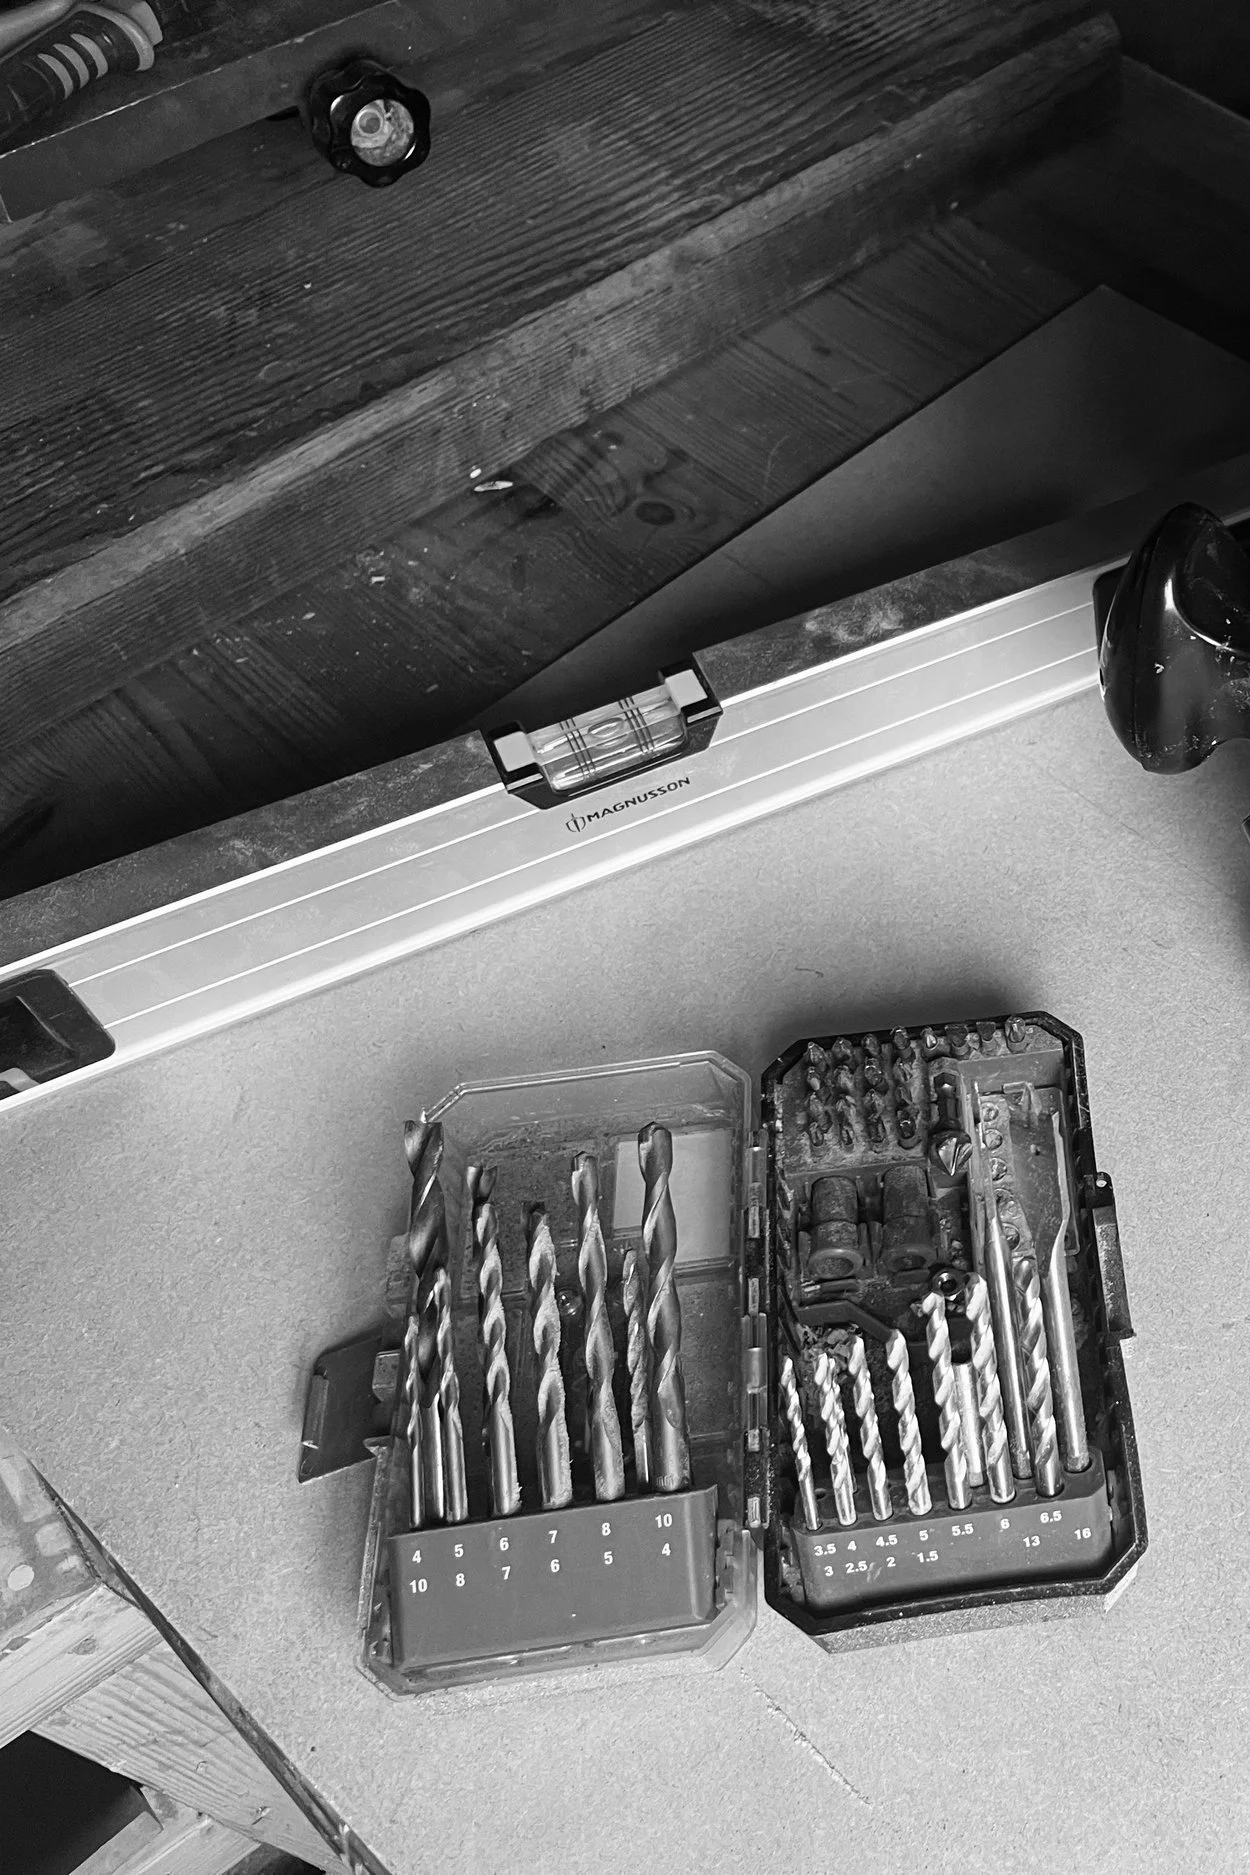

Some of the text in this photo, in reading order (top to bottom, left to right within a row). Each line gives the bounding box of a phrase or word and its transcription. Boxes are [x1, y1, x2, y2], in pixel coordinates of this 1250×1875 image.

[586, 776, 691, 823] MAGNUSSON
[412, 1513, 673, 1564] 4 5 6 7 8 10
[813, 1510, 1062, 1557] 3.5 4 4.5 5 5.5 6 6.5
[823, 1565, 834, 1577] 3
[845, 1560, 868, 1574] 2.5
[886, 1556, 897, 1568] 2
[916, 1550, 939, 1563] 1.5
[1022, 1535, 1041, 1547] 13
[409, 1542, 671, 1594] 10 8 7 6 5 4
